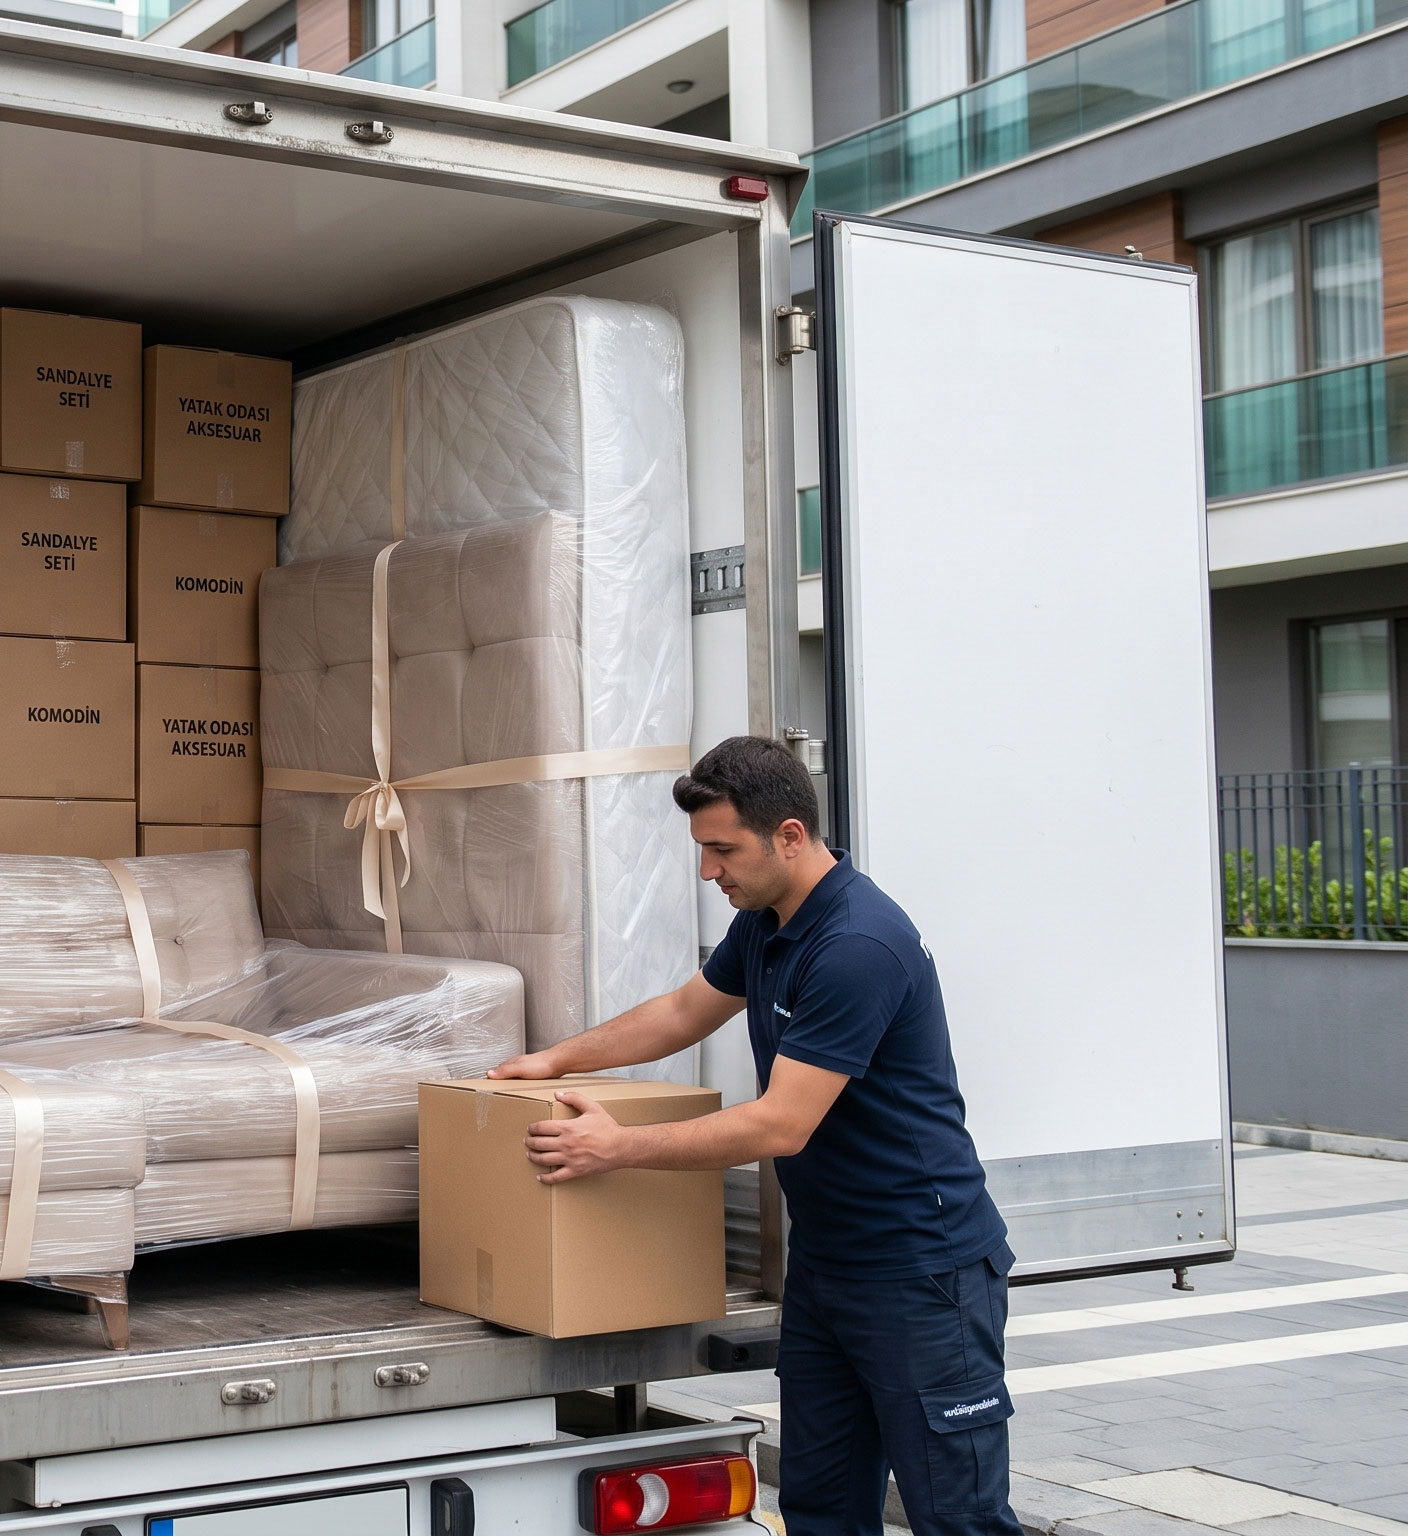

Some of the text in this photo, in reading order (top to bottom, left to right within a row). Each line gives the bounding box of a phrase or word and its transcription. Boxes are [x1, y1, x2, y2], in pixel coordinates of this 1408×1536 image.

[36, 366, 113, 389] SANDALYE
[59, 390, 90, 409] SETİ
[178, 397, 270, 422] YATAK ODASI
[187, 421, 262, 443] AKSESUAR
[21, 531, 98, 552] SANDALYE
[44, 553, 75, 572] SETİ
[175, 575, 244, 595] KOMODİN
[28, 705, 101, 725] KOMODİN
[162, 718, 254, 736] YATAK ODASI
[171, 740, 247, 758] AKSESUAR
